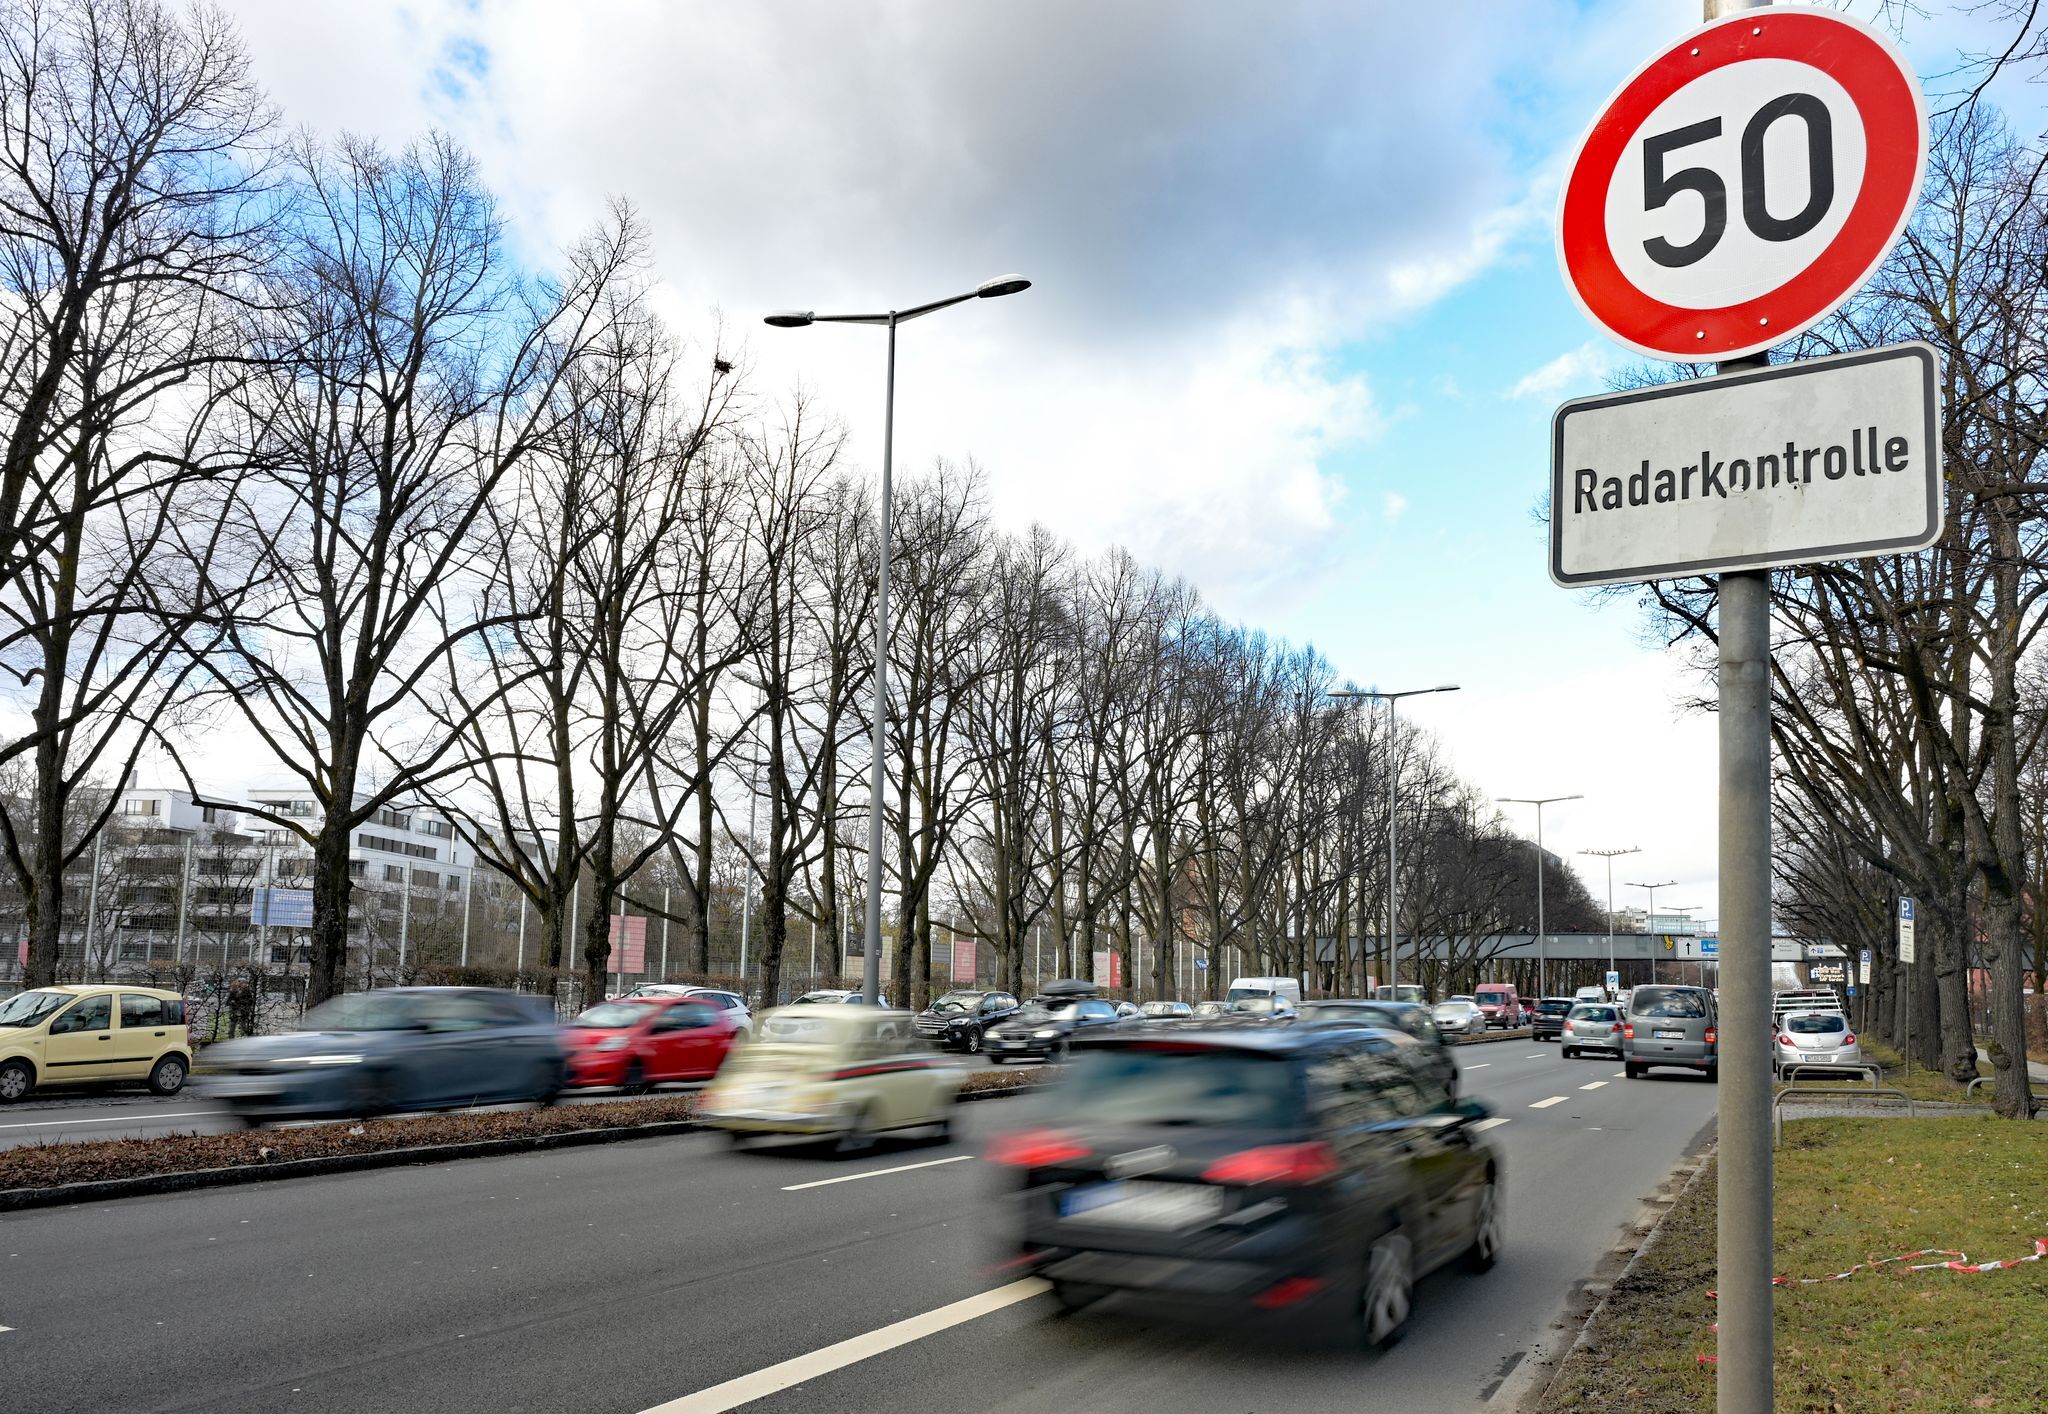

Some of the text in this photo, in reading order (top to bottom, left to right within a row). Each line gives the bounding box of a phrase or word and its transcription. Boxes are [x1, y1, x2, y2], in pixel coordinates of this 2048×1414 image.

[1643, 93, 1835, 268] 50
[1573, 427, 1909, 515] Radarkontrolle
[1901, 900, 1909, 917] P
